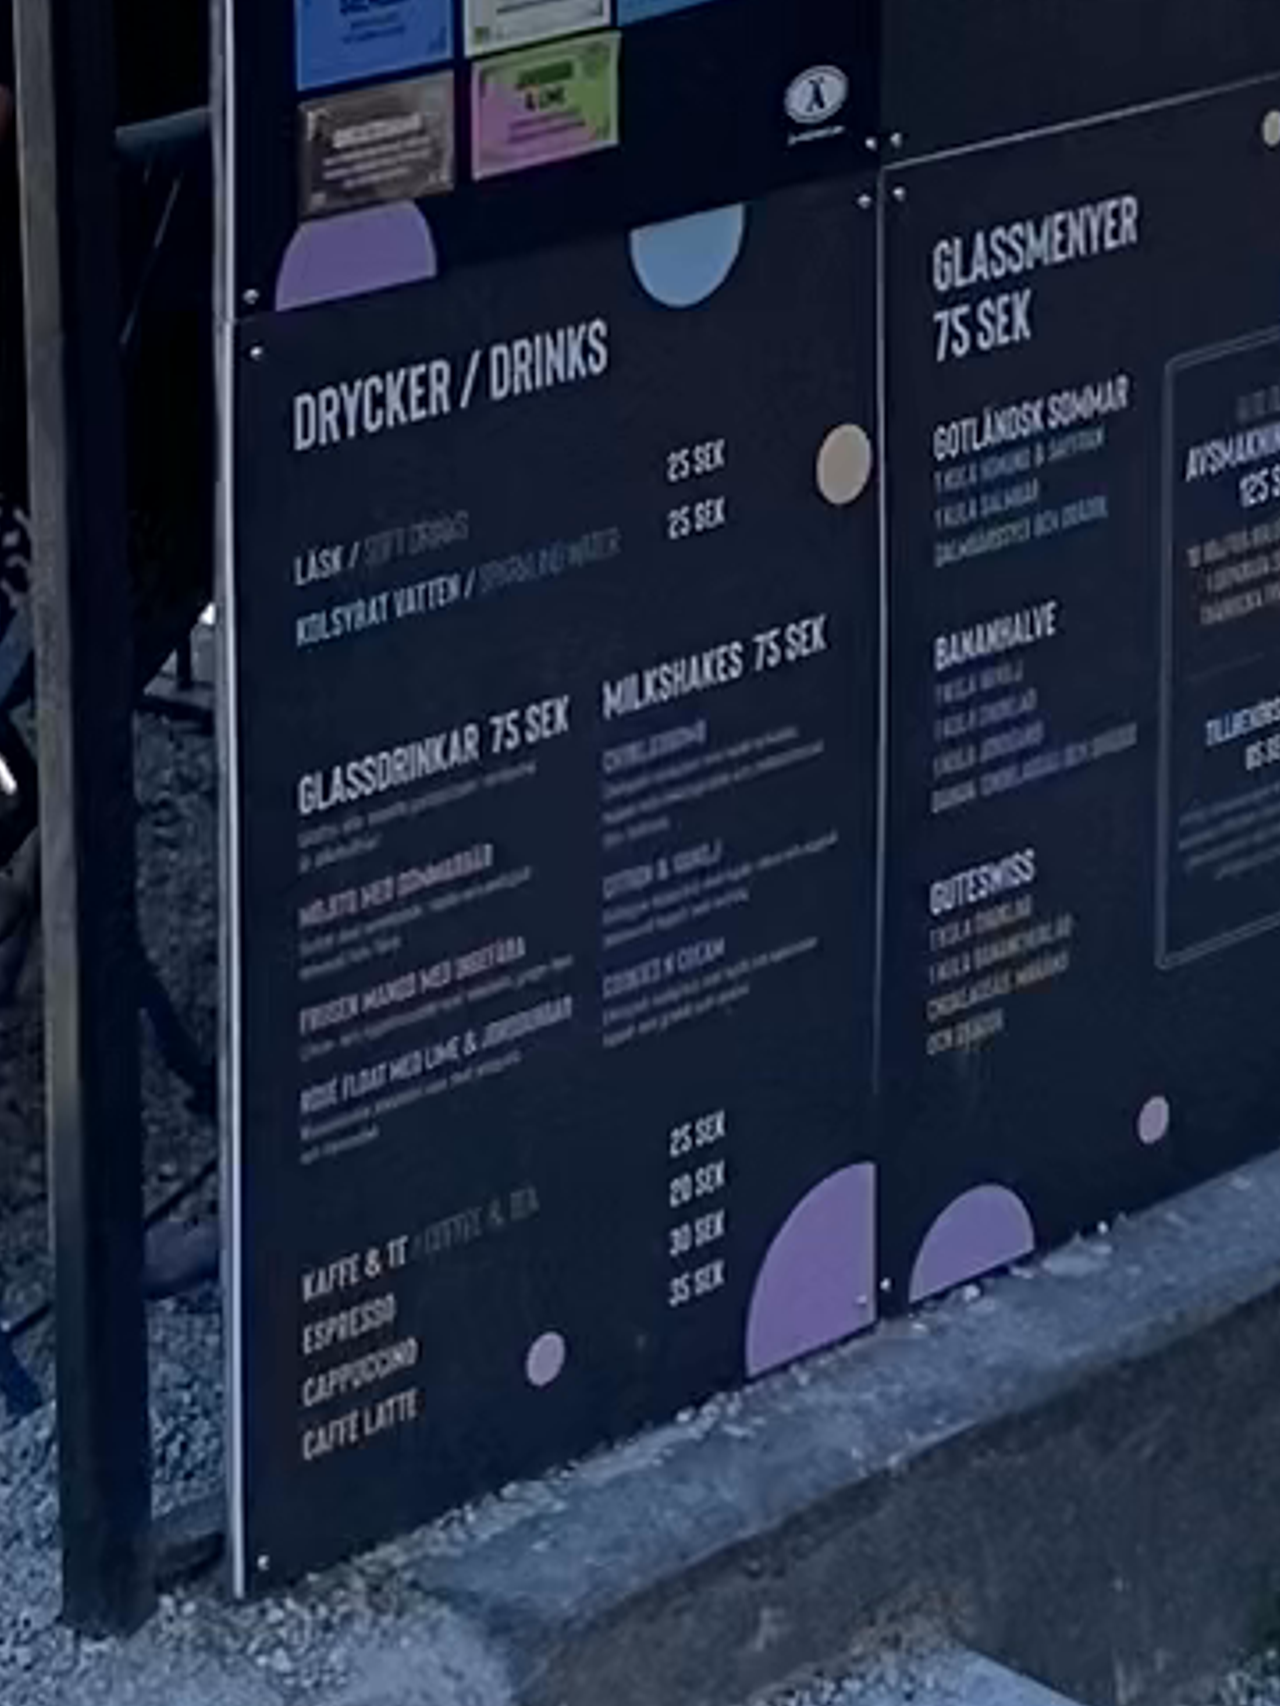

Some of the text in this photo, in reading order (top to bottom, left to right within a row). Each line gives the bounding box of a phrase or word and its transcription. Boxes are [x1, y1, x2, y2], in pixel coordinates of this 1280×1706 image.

[932, 192, 1139, 293] GLASSMENYER
[932, 287, 1033, 362] 75 SEK
[293, 317, 609, 452] DRYCKER / DRINKS
[1046, 372, 1131, 430] SOMMAR
[666, 437, 726, 484] 25 SEK
[666, 494, 726, 541] 25 SEK
[294, 546, 344, 587] LÄSK
[295, 591, 389, 649] KOLSYRAT
[393, 571, 462, 619] VATTEN
[601, 612, 830, 721] MILKSHAKES 75 SEK
[297, 693, 571, 817] GLASSDRINKAR 75 SEK
[668, 1108, 726, 1159] 25 SEK
[693, 1158, 726, 1200] SEK
[668, 1207, 726, 1258] 30 SEK
[302, 1260, 361, 1304] KAFFE
[363, 1246, 382, 1278] &
[668, 1257, 726, 1308] 35 SEK
[302, 1291, 398, 1355] ESPRESSO
[302, 1334, 420, 1408] CAPPUCCINO
[362, 1386, 420, 1437] LATTE
